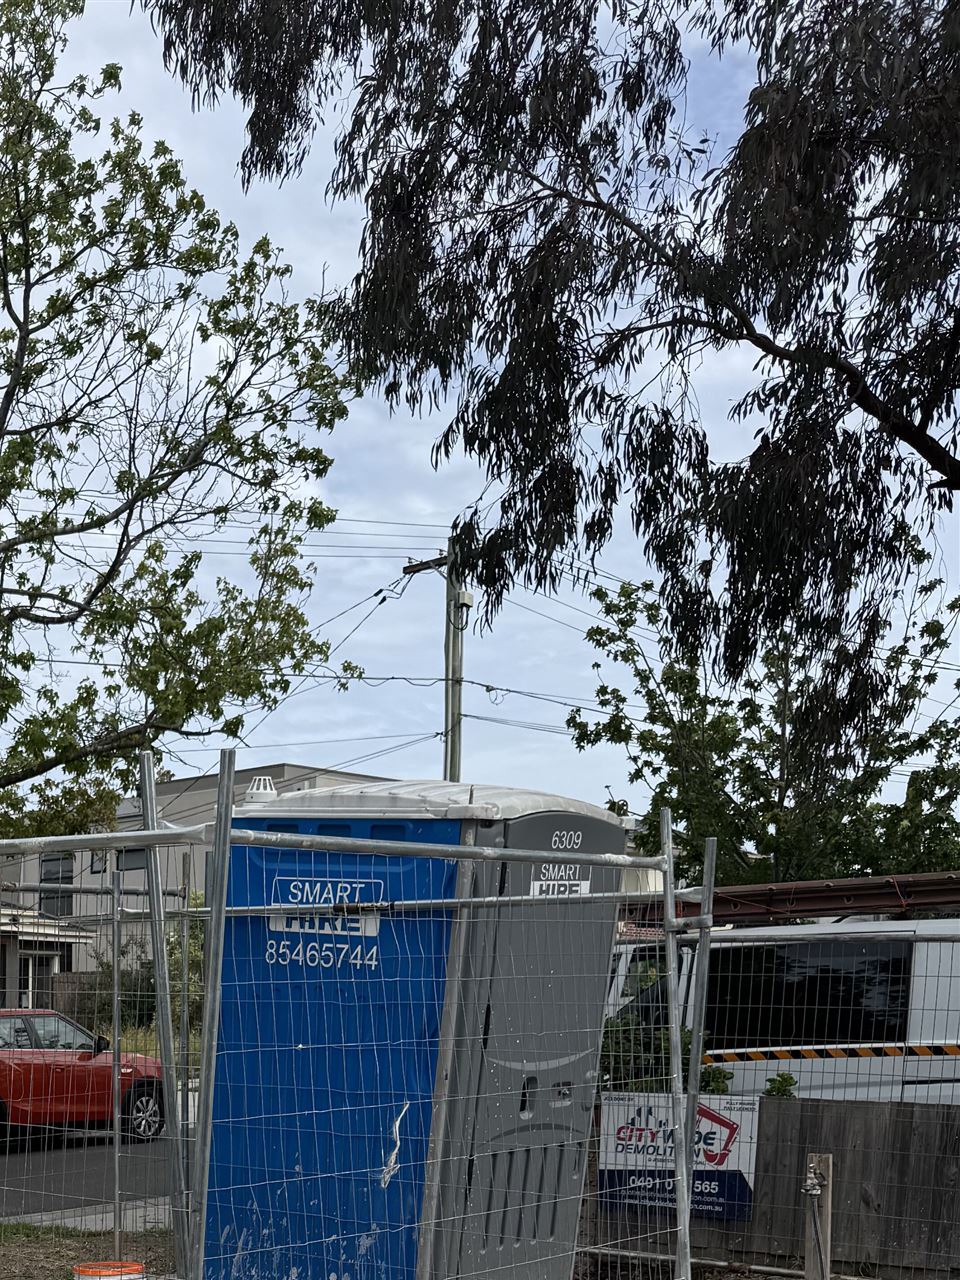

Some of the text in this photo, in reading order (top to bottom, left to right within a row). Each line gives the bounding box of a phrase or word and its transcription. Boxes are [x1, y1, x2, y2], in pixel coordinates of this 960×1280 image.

[551, 830, 582, 849] 6309
[540, 863, 581, 880] SMART
[288, 881, 365, 904] SMART
[539, 883, 581, 896] HIRE
[265, 940, 378, 971] 85465744
[616, 1143, 701, 1158] DEMOLITN
[693, 1180, 719, 1194] 565
